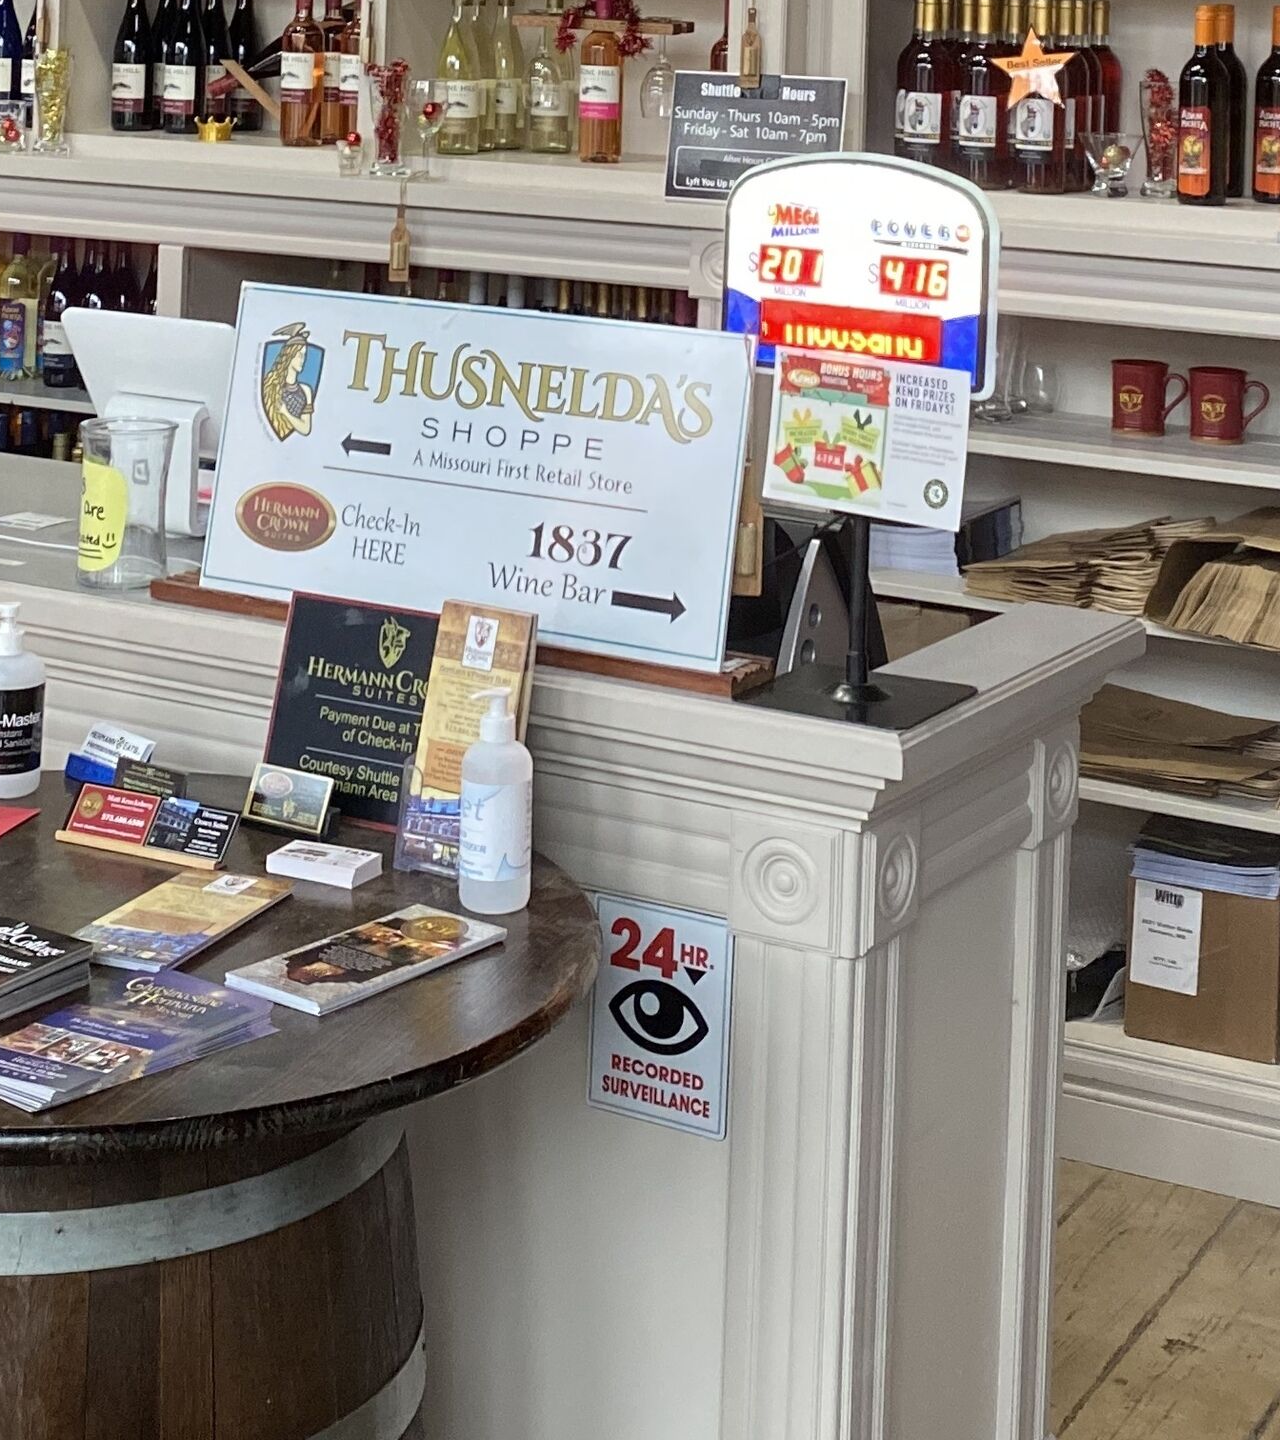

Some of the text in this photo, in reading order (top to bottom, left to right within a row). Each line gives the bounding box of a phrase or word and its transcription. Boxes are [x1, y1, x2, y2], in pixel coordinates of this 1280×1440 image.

[1007, 58, 1062, 69] Best Seller
[701, 83, 816, 102] Shuttle Hours
[675, 106, 840, 130] Sunday Thurs 10am 5pm
[684, 122, 827, 146] Friday Sat 10am 7pm
[686, 177, 728, 189] Lyft You Up
[821, 363, 850, 377] BONUS
[852, 367, 883, 382] HOURS
[896, 373, 948, 390] INCREASED
[895, 397, 955, 416] ON FRIDAYS!
[896, 386, 920, 398] KENO
[923, 389, 956, 403] PRIZES
[420, 417, 605, 461] SHOPPE
[413, 450, 633, 495] A Missouri First Retail Store
[253, 496, 320, 520] HERMANN
[256, 513, 309, 534] CROWN
[342, 503, 421, 538] Check-In
[352, 536, 407, 566] HERE
[528, 521, 633, 571] 1837
[487, 562, 606, 607] Wine Bar
[307, 655, 395, 690] HERMANN
[352, 686, 418, 706] SUITES
[320, 706, 410, 735] Payment Due at
[342, 729, 355, 742] of
[299, 754, 400, 786] Courtesy Shuttle
[368, 786, 398, 803] Area
[610, 917, 714, 979] 24 HR.
[612, 1054, 703, 1090] RECORDED
[602, 1075, 710, 1118] SURVEILLANCE
